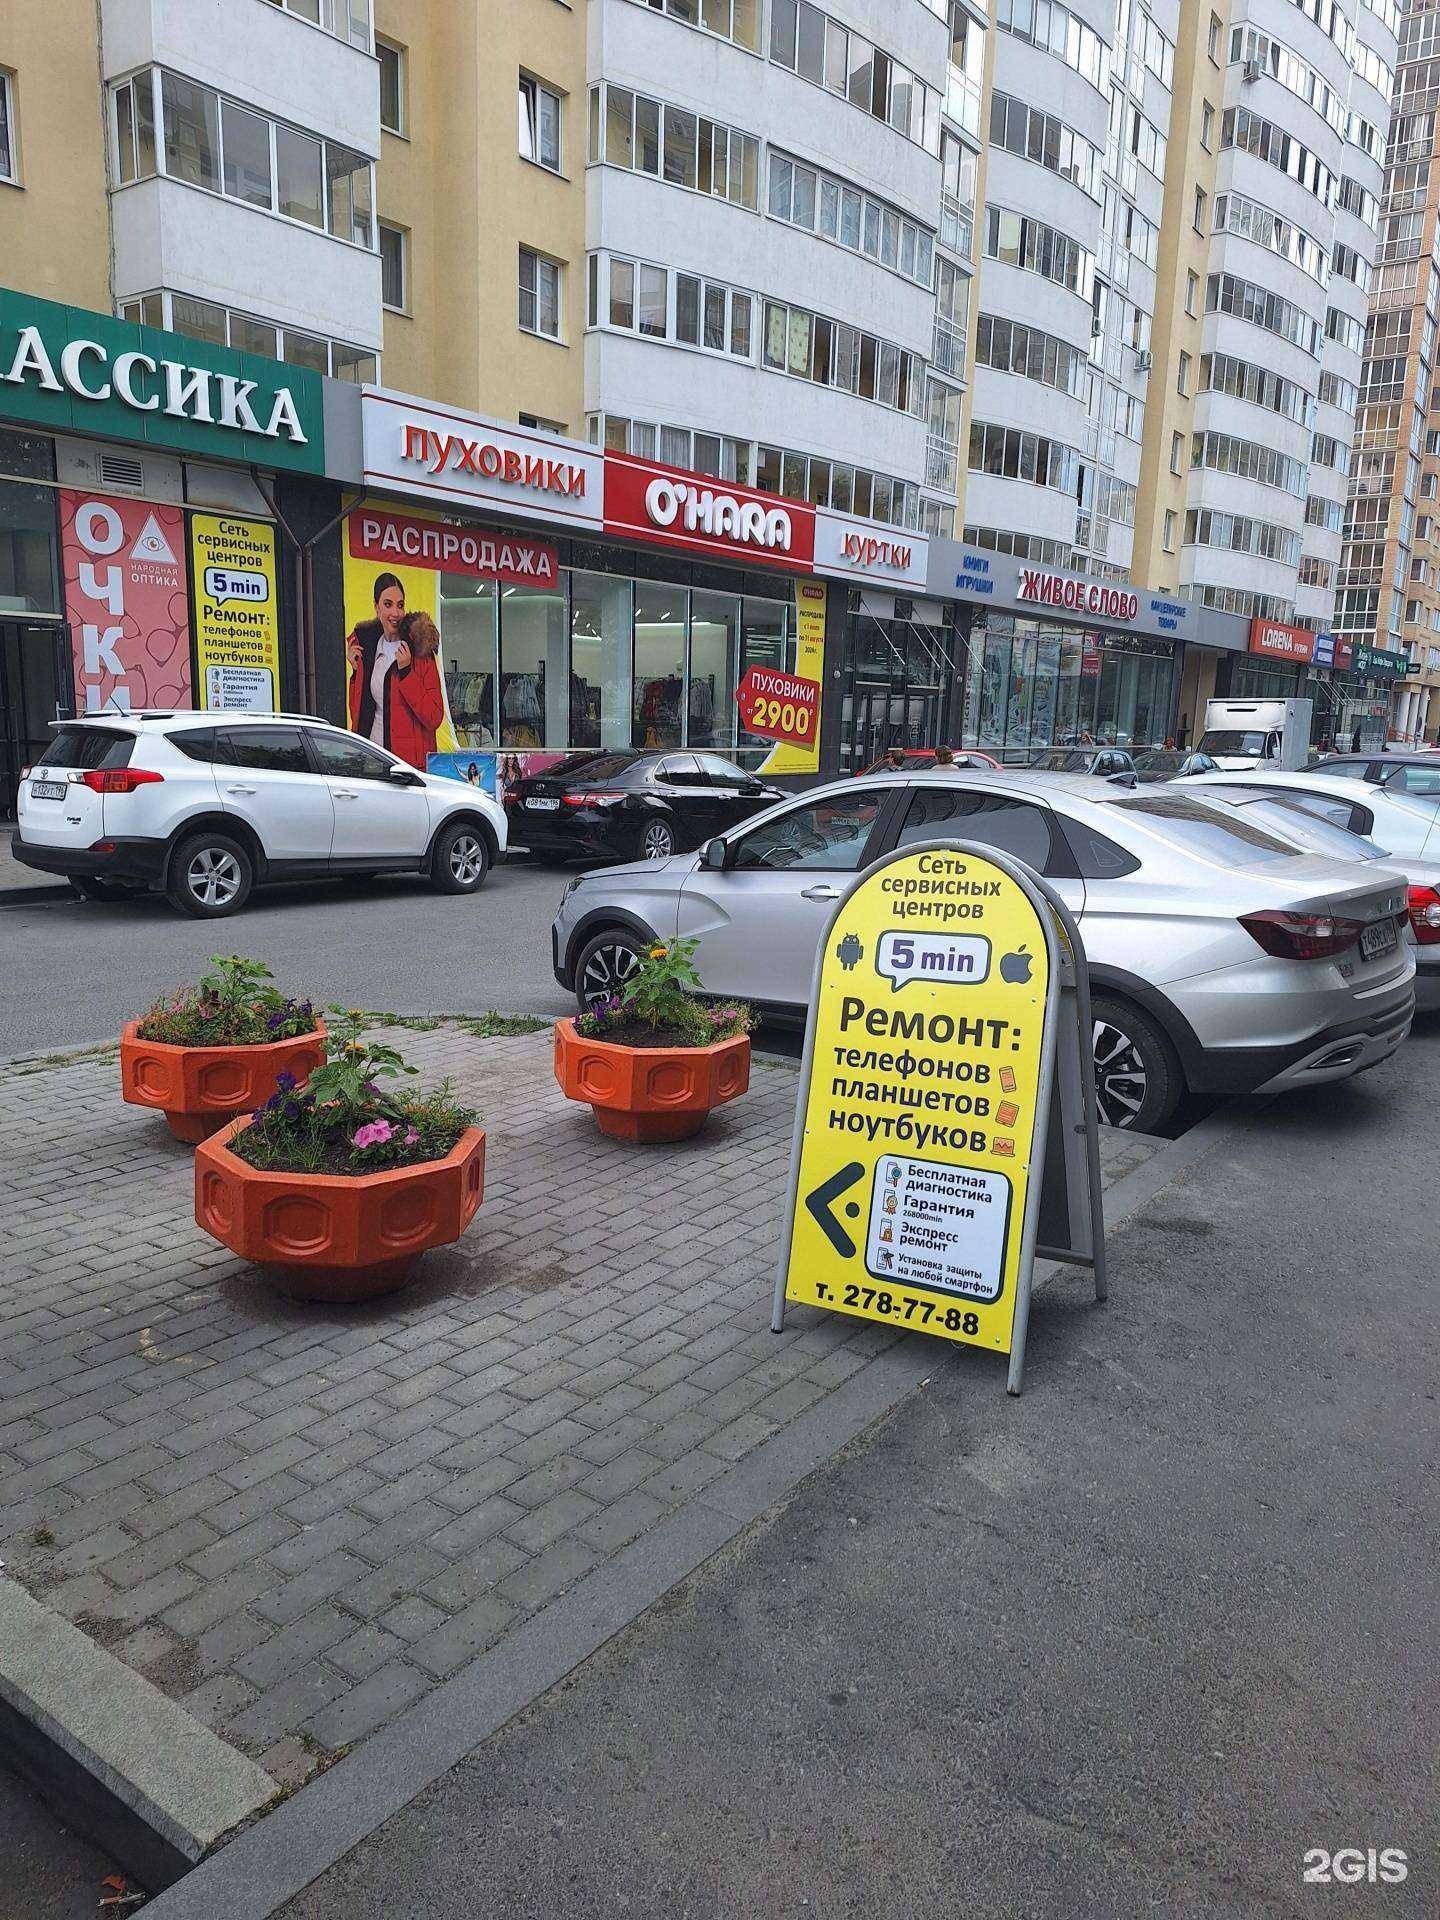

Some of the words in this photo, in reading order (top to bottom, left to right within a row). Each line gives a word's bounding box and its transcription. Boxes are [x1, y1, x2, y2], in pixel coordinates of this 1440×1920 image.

[0, 326, 309, 443] АССИКА
[400, 424, 586, 497] ПУХОВИКИ
[645, 477, 791, 551] O'HARA
[219, 521, 249, 537] Сеть
[197, 534, 271, 554] сервисных
[363, 520, 552, 578] РАСПРОДАЖА
[841, 533, 911, 568] КУРТКИ
[131, 563, 178, 576] НАРОДНАЯ
[207, 551, 262, 567] центров
[963, 555, 989, 574] КНИГИ
[131, 573, 178, 587] ОПТИКА
[213, 572, 227, 592] 5
[231, 580, 261, 595] min
[956, 574, 994, 594] ИГРУШКИ
[1022, 569, 1085, 610] ЖИВОЕ
[1089, 585, 1138, 621] СЛОВО
[203, 605, 270, 626] Ремонт:
[203, 625, 262, 638] телефонов
[1261, 627, 1293, 651] LORENA
[204, 638, 263, 651] планшетов
[205, 651, 264, 664] ноутбуков
[751, 672, 815, 703] ПУХОВИКИ
[752, 696, 809, 735] 2900
[918, 855, 967, 875] Сеть
[881, 877, 1001, 897] сервисных
[892, 899, 984, 921] центров
[890, 939, 915, 970] 5
[921, 946, 974, 973] min
[839, 996, 1021, 1051] Ремонт:
[834, 1046, 991, 1083] телефонов
[832, 1077, 991, 1116] планшетов
[829, 1110, 987, 1152] ноутбуков
[908, 1165, 986, 1189] Бесплатная
[905, 1180, 992, 1203] диагностика
[903, 1194, 975, 1218] Гарантия
[903, 1209, 943, 1223] 268000min
[899, 1233, 948, 1253] ремонт
[901, 1222, 959, 1243] Экспресс
[898, 1253, 943, 1270] Установка
[946, 1264, 982, 1280] защиты
[897, 1266, 909, 1276] на
[910, 1268, 943, 1284] любой
[944, 1277, 993, 1295] смартфон
[815, 1282, 834, 1302] т.
[843, 1284, 979, 1336] 278-77-88
